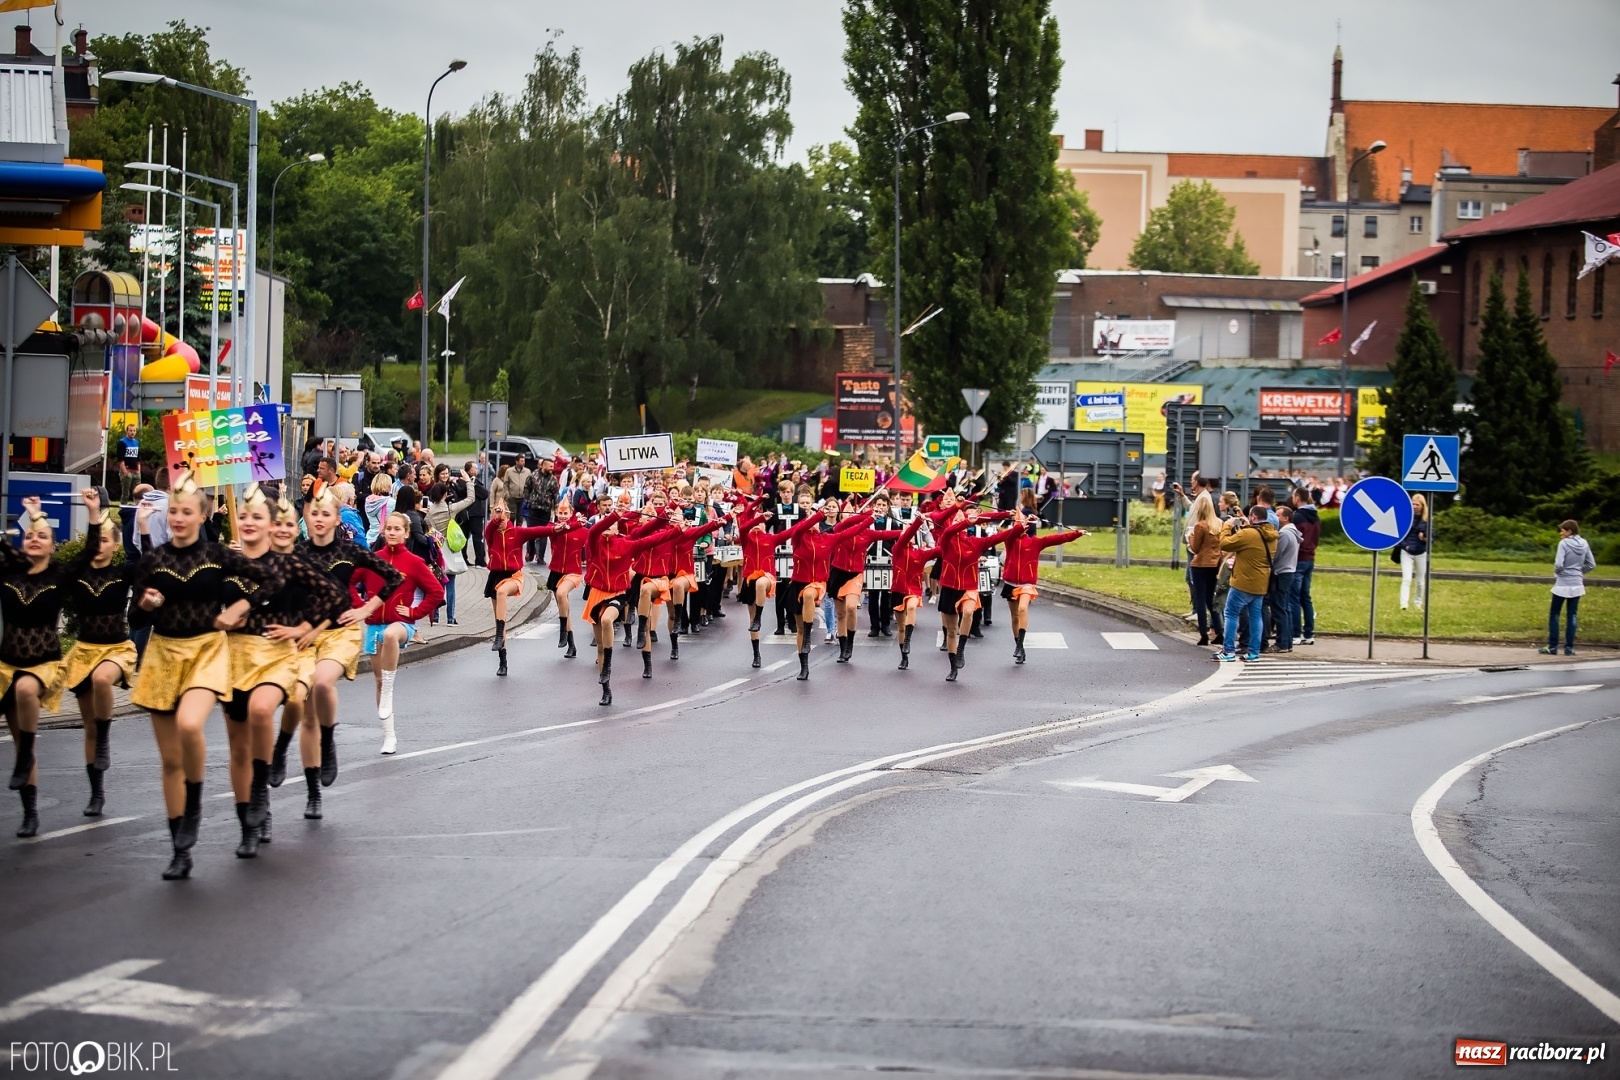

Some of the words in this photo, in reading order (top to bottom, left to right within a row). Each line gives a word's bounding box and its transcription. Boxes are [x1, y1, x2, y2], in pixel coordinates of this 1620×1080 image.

[842, 379, 880, 391] Taste
[1262, 394, 1347, 408] KREWETKA
[177, 411, 264, 433] TĘCZA
[173, 430, 272, 452] RACIBÓRZ
[195, 451, 255, 468] POLSKA
[619, 446, 659, 461] LITWA
[845, 471, 869, 481] TĘCZA
